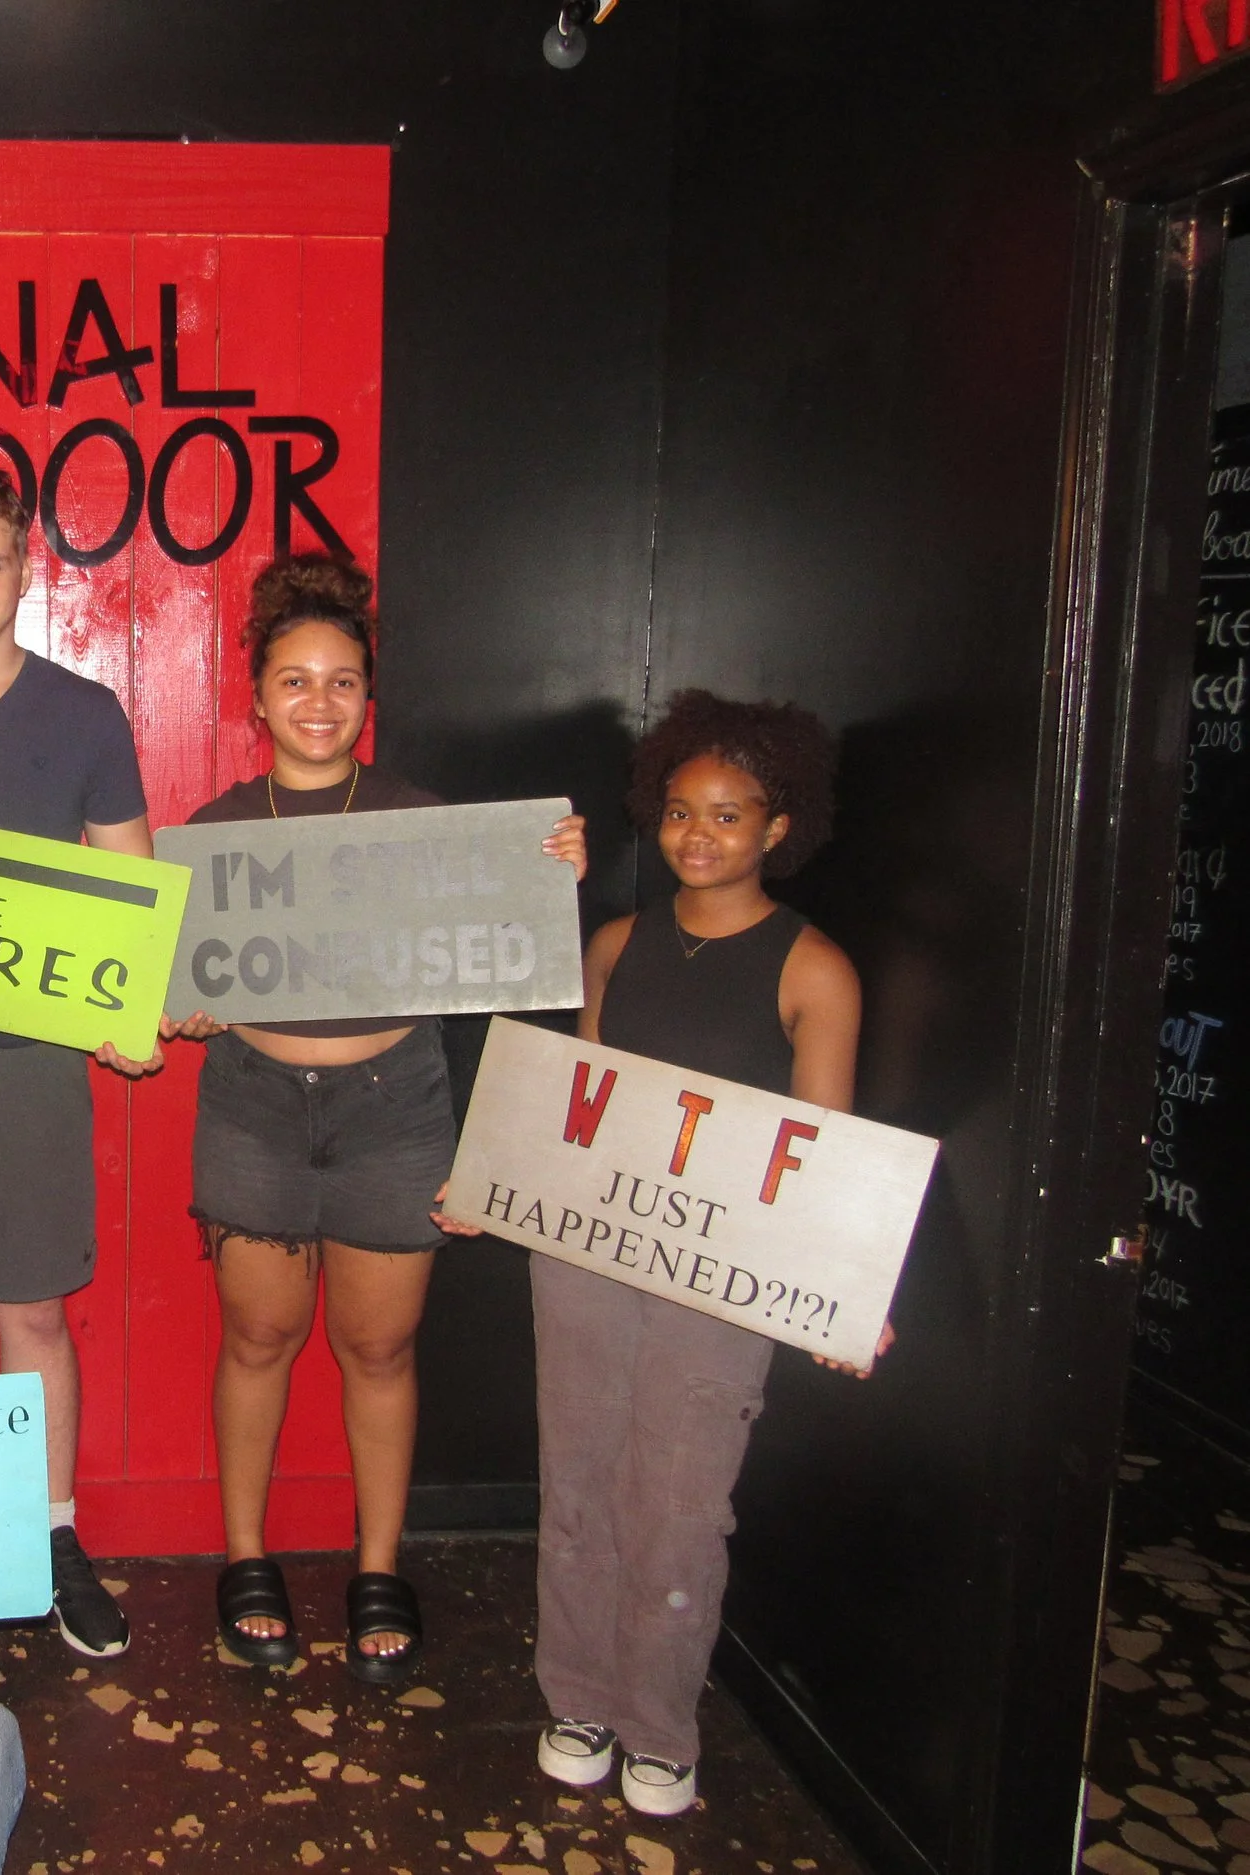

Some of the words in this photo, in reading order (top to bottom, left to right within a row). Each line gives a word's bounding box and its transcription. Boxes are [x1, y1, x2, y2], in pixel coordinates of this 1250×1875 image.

[211, 849, 296, 912] I'M
[330, 838, 503, 900] STILL
[191, 921, 536, 998] CONFUSED
[1166, 922, 1201, 943] 017
[599, 1170, 726, 1238] JUST
[483, 1182, 838, 1338] HAPPENED?!?!
